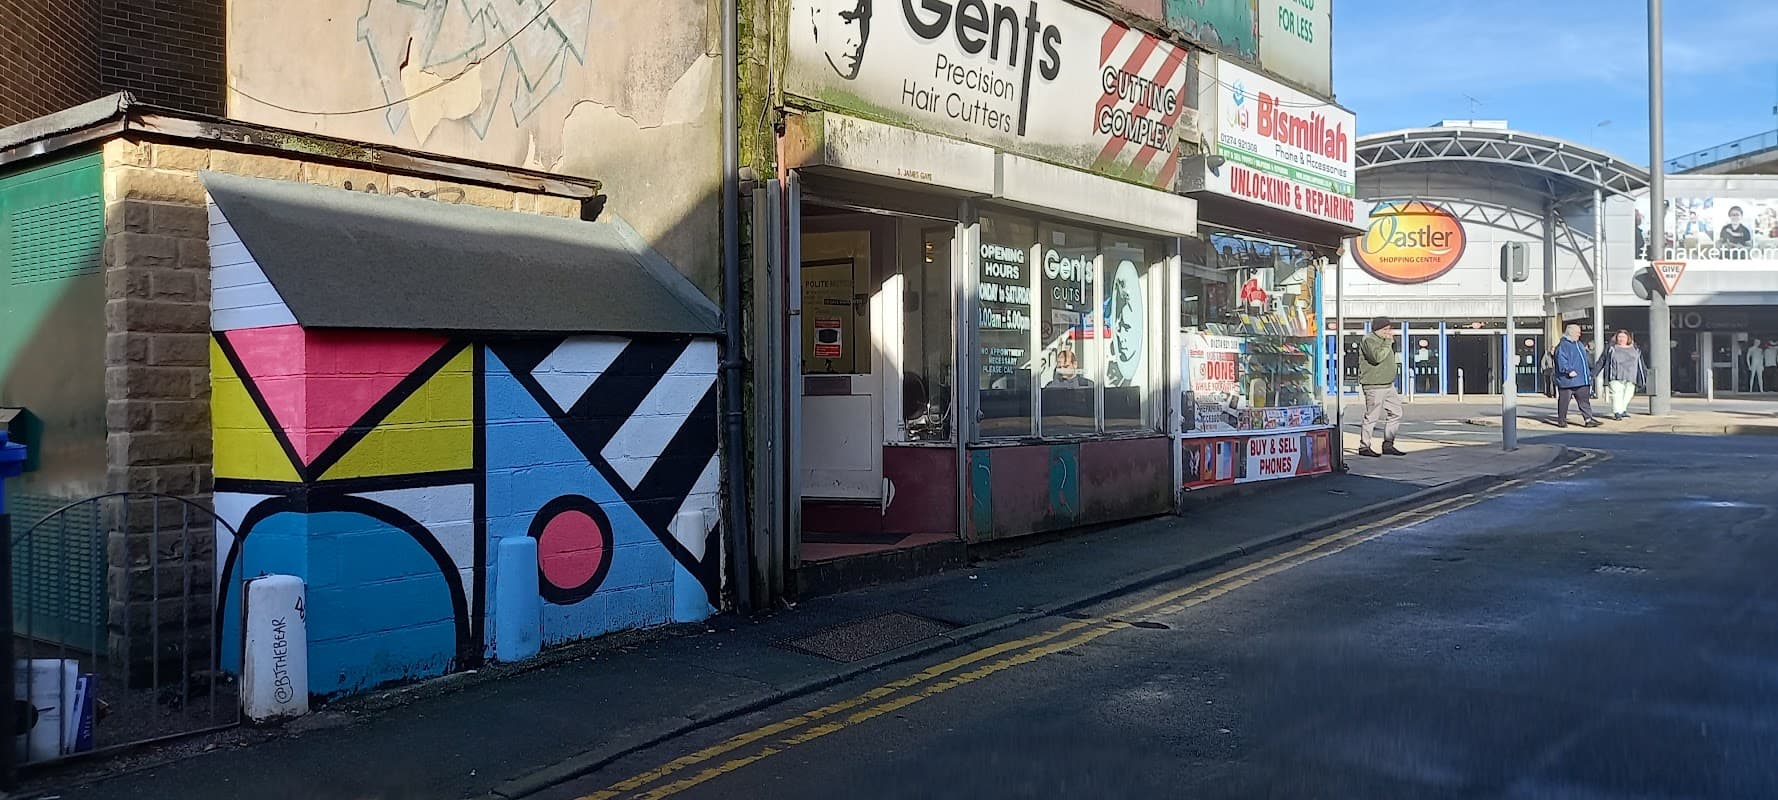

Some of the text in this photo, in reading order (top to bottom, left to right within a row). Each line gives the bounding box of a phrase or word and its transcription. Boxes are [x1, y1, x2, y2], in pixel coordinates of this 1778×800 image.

[1278, 6, 1314, 43] FOR LESS
[935, 53, 1014, 101] Precision
[1102, 65, 1177, 116] CUTTING
[902, 78, 1011, 132] Hair Cutters
[1098, 104, 1174, 153] COMPLEX
[1257, 91, 1348, 163] Bismillah
[1275, 144, 1298, 162] Phone
[1299, 152, 1305, 164] &
[1306, 154, 1348, 178] Accessories
[1230, 166, 1290, 207] UNLOCKING
[1294, 185, 1302, 210] &
[1306, 188, 1354, 223] REPAIRING
[1361, 215, 1453, 254] Oastler
[980, 244, 1025, 264] OPENING
[985, 262, 1020, 279] HOURS
[1662, 265, 1680, 273] GIVE
[977, 282, 999, 302] ONDAY
[1044, 249, 1094, 304] Gents
[1053, 286, 1080, 302] CUTS
[1207, 361, 1234, 380] DONE
[1250, 437, 1297, 456] BUY & SELL
[1259, 456, 1292, 475] PHONES
